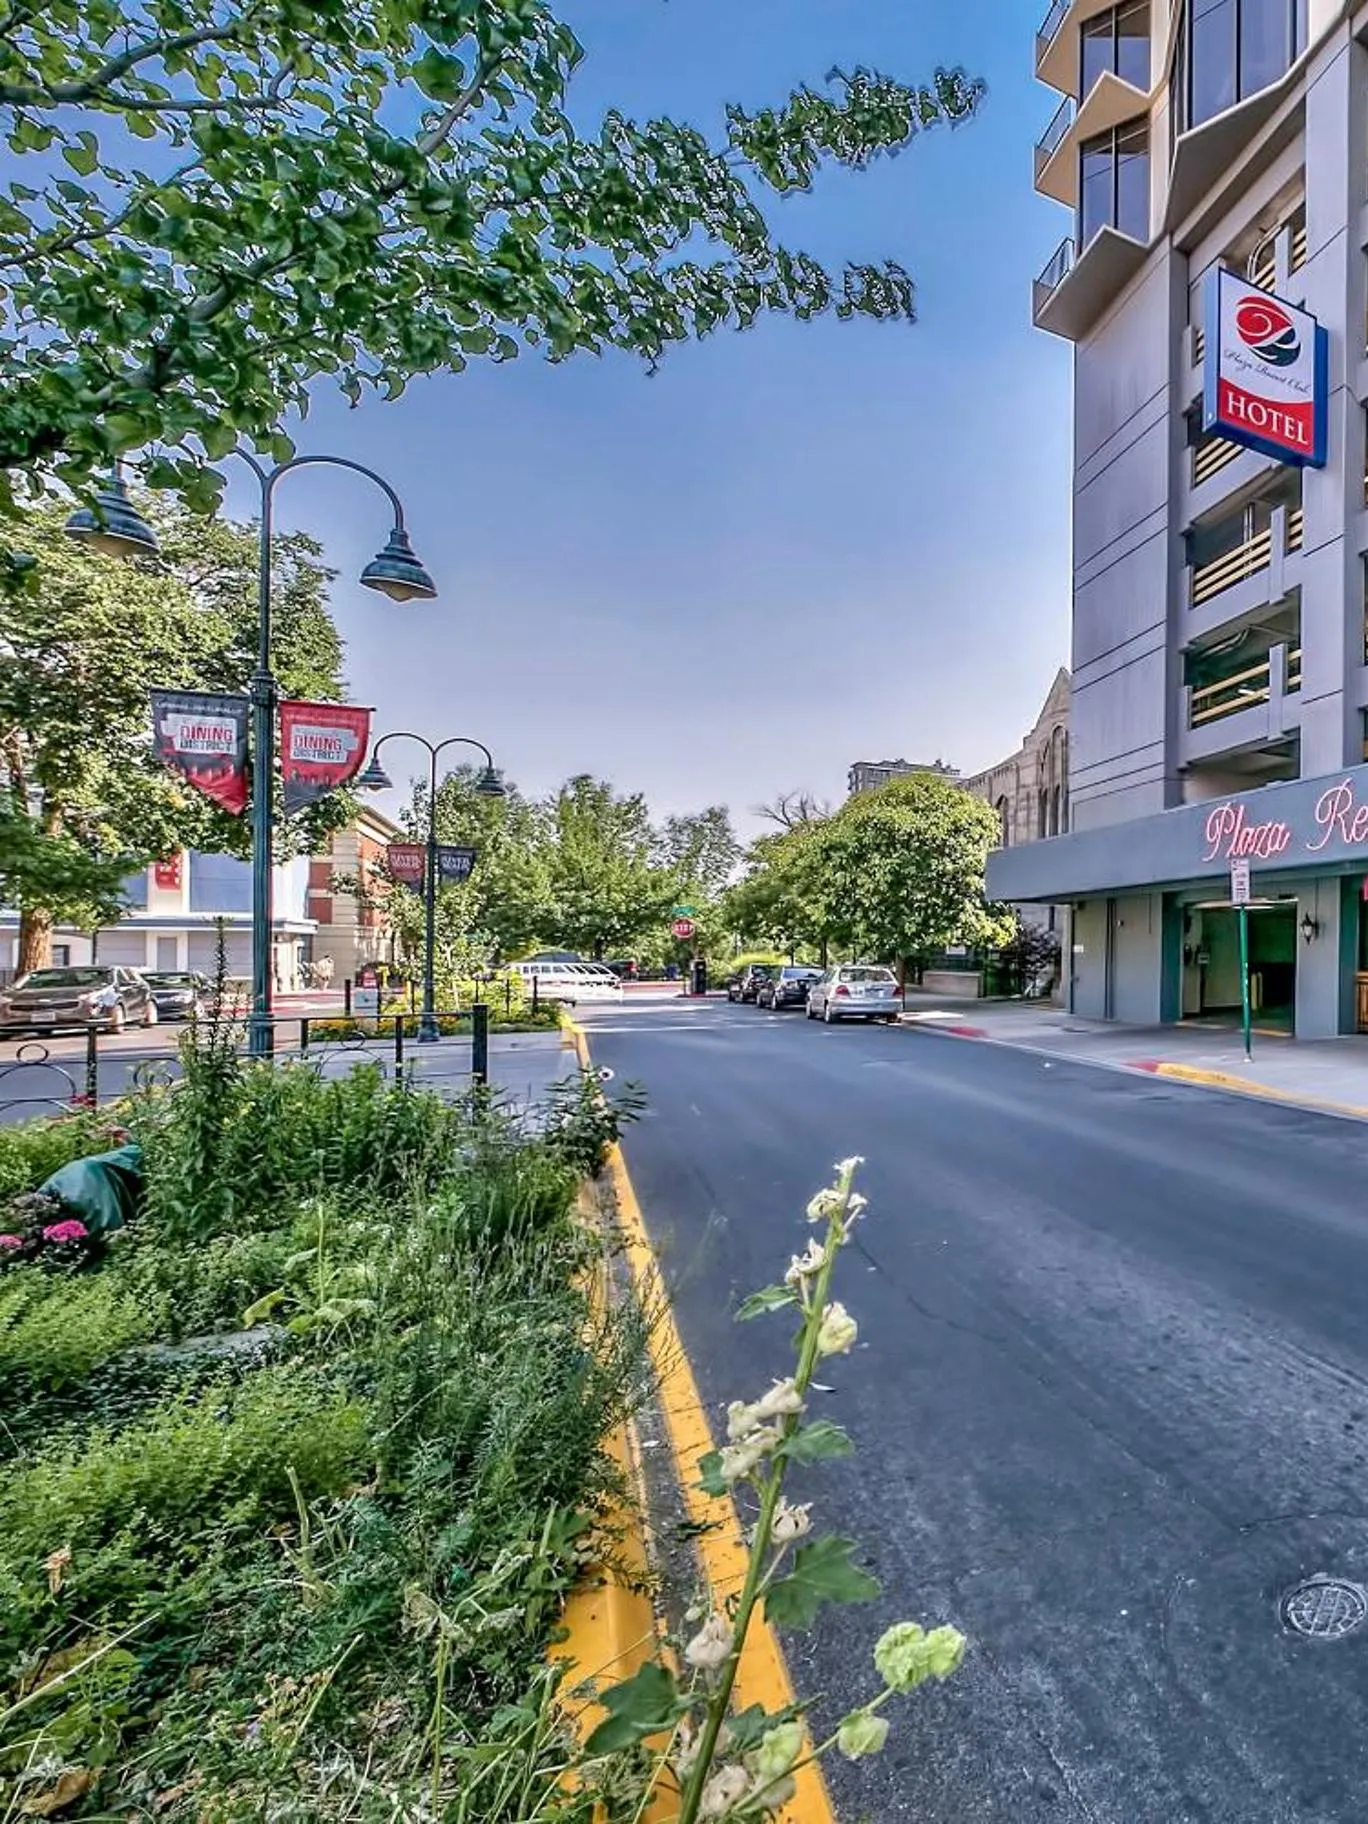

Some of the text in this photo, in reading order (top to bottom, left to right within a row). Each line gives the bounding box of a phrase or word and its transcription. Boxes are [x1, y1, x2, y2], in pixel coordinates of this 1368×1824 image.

[1227, 390, 1308, 445] HOTEL
[180, 726, 233, 741] DINING
[180, 739, 232, 751] DISTRICT
[293, 735, 342, 751] DINING
[1202, 801, 1290, 861] Plaza
[673, 923, 694, 932] STOP
